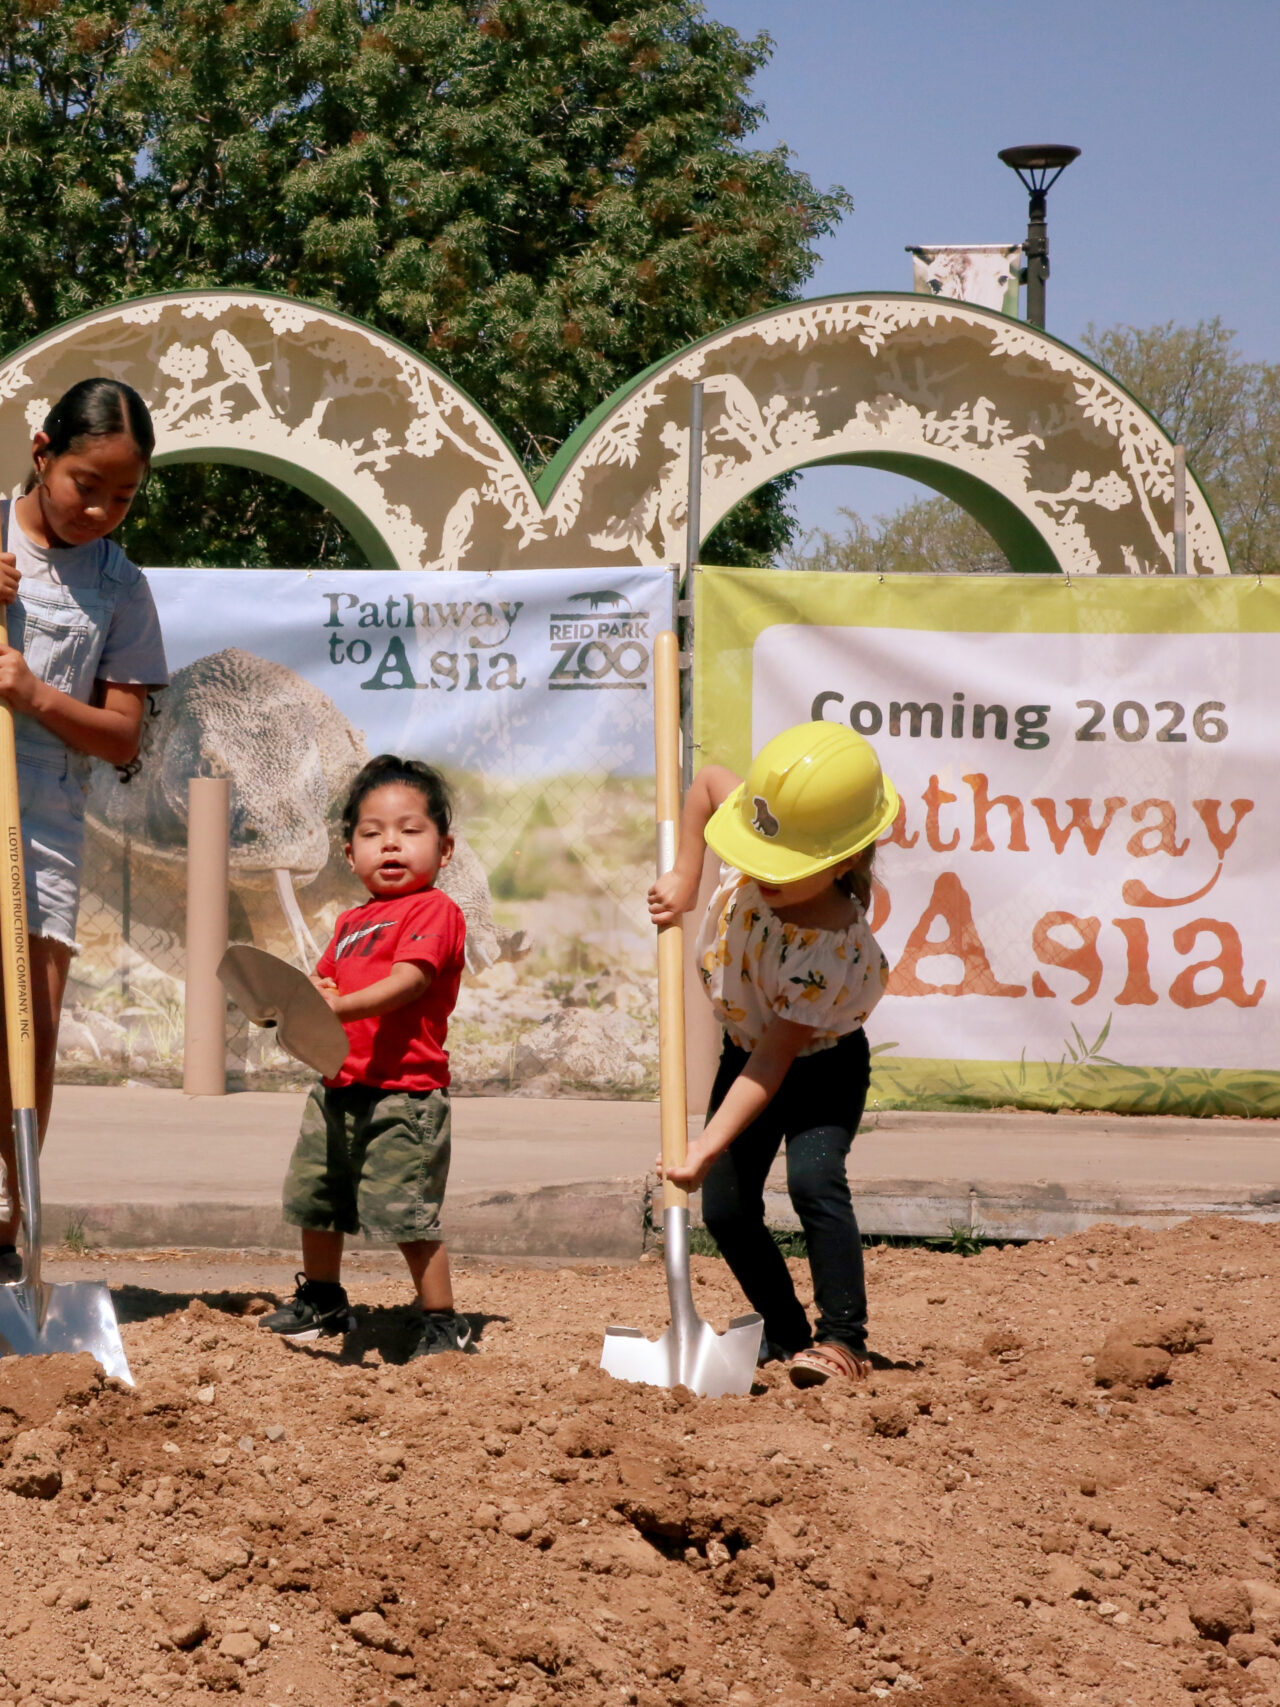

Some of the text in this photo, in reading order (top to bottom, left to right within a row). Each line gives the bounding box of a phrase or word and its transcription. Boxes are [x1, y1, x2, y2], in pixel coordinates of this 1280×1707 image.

[322, 592, 524, 649] Pathway
[549, 622, 650, 640] REID PARK
[328, 631, 526, 691] to Asia
[548, 641, 650, 679] ZOO
[811, 690, 1229, 750] Coming 2026
[8, 826, 30, 1043] LLOYD CONSTRUCTION COMPANY, INC.
[883, 871, 1267, 1008] Asia
